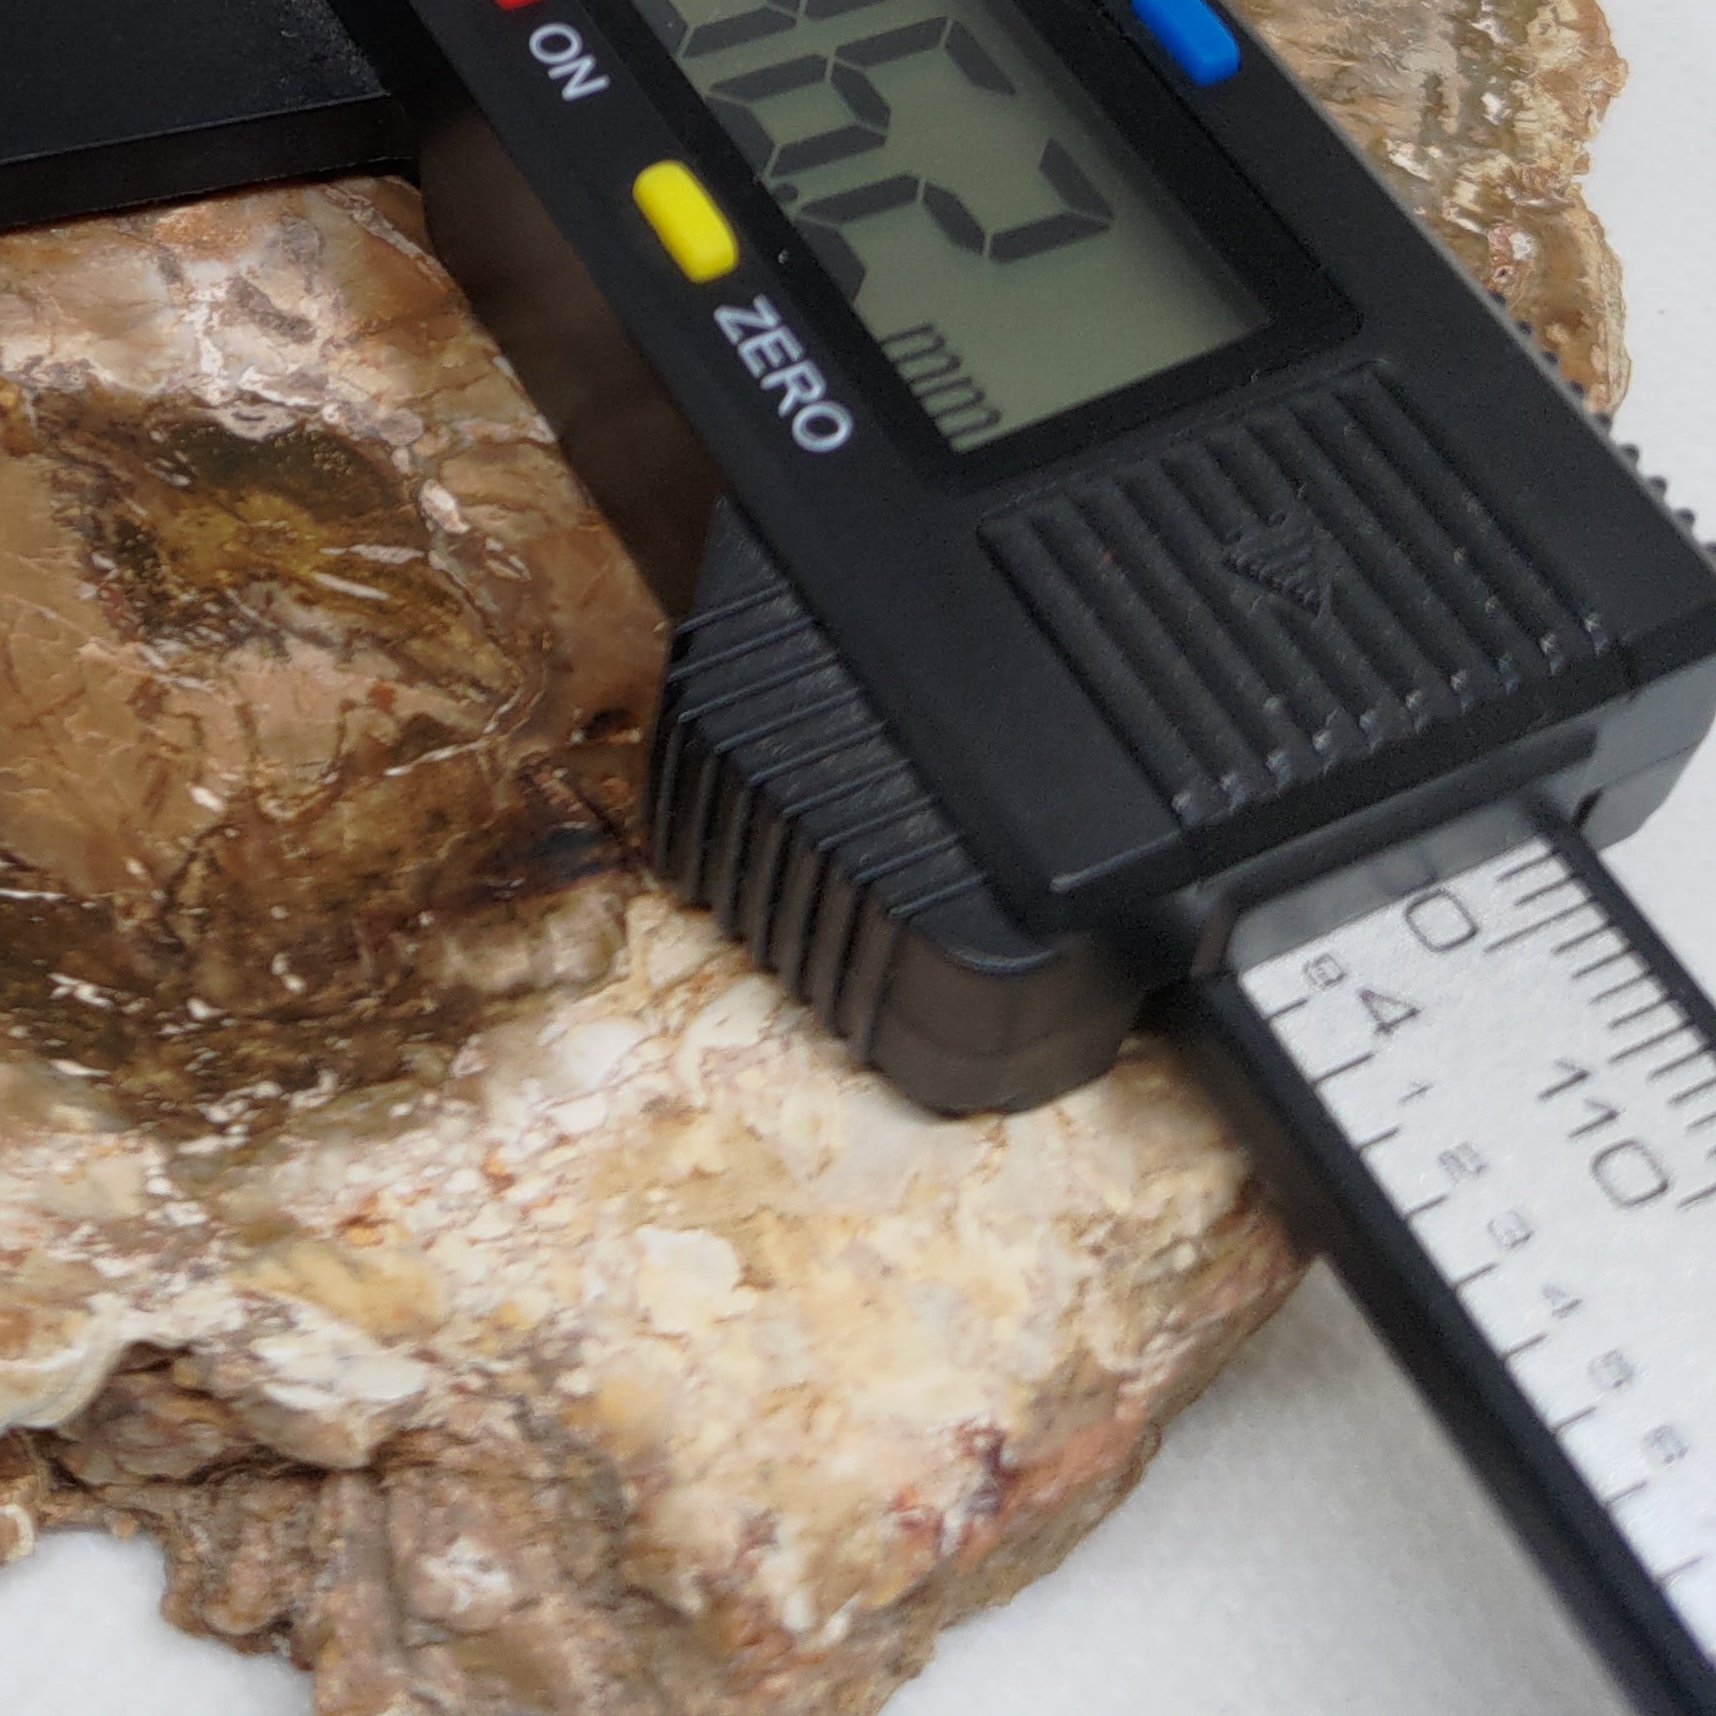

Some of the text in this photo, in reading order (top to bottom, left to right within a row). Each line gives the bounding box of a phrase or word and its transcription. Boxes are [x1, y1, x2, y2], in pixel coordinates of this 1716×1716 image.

[527, 22, 609, 101] ON
[713, 294, 854, 452] ZERO
[1357, 988, 1421, 1035] 4
[1537, 1057, 1670, 1208] 110
